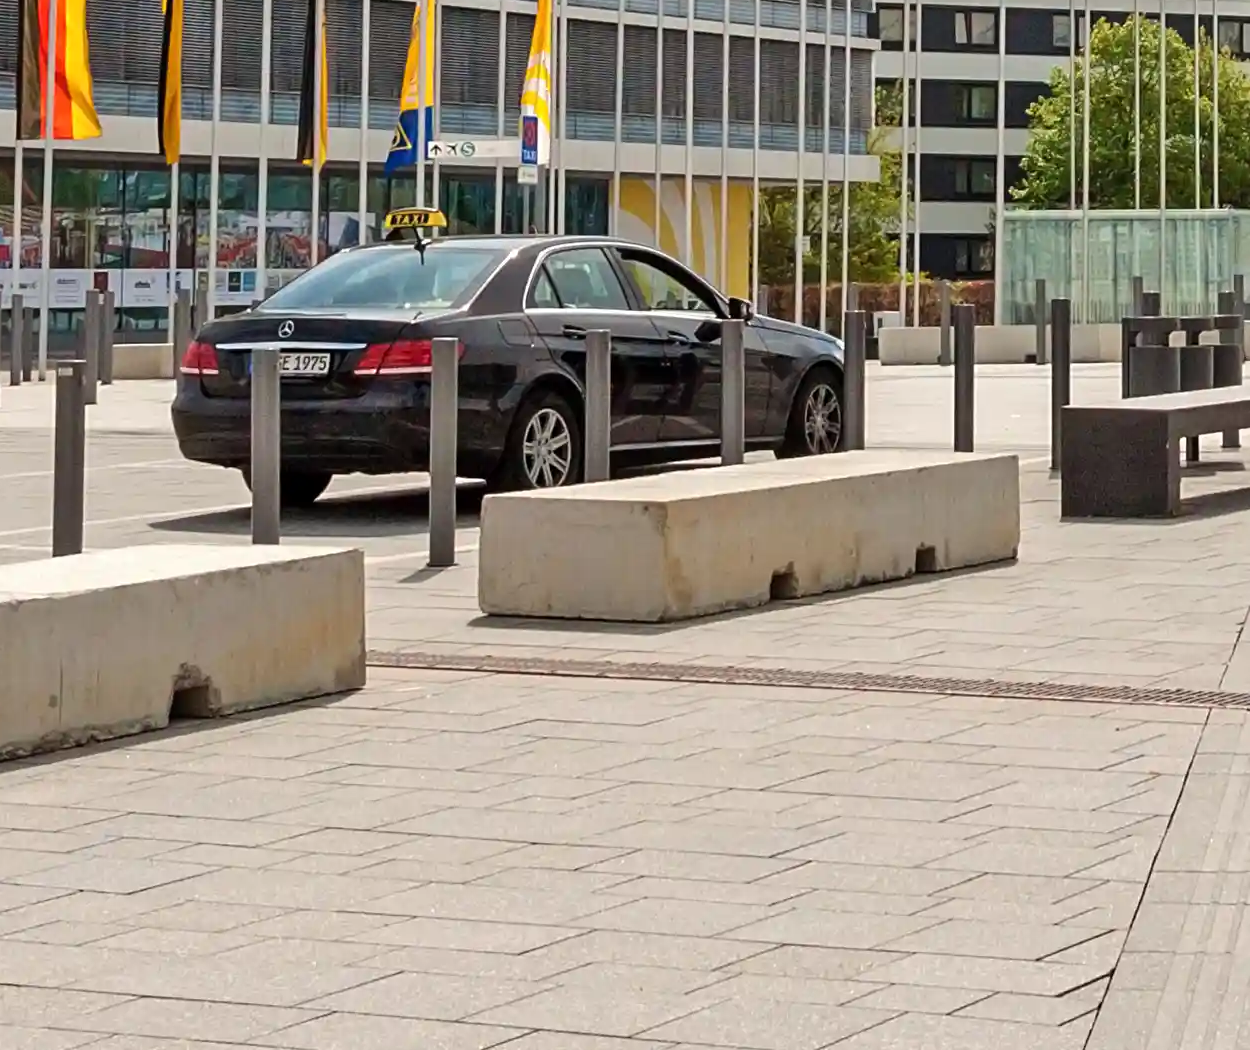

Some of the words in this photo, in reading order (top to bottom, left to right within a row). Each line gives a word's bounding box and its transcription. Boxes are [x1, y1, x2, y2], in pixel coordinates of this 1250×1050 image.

[523, 149, 537, 161] TAXI
[395, 213, 425, 225] TAXI
[293, 355, 328, 371] 1975
